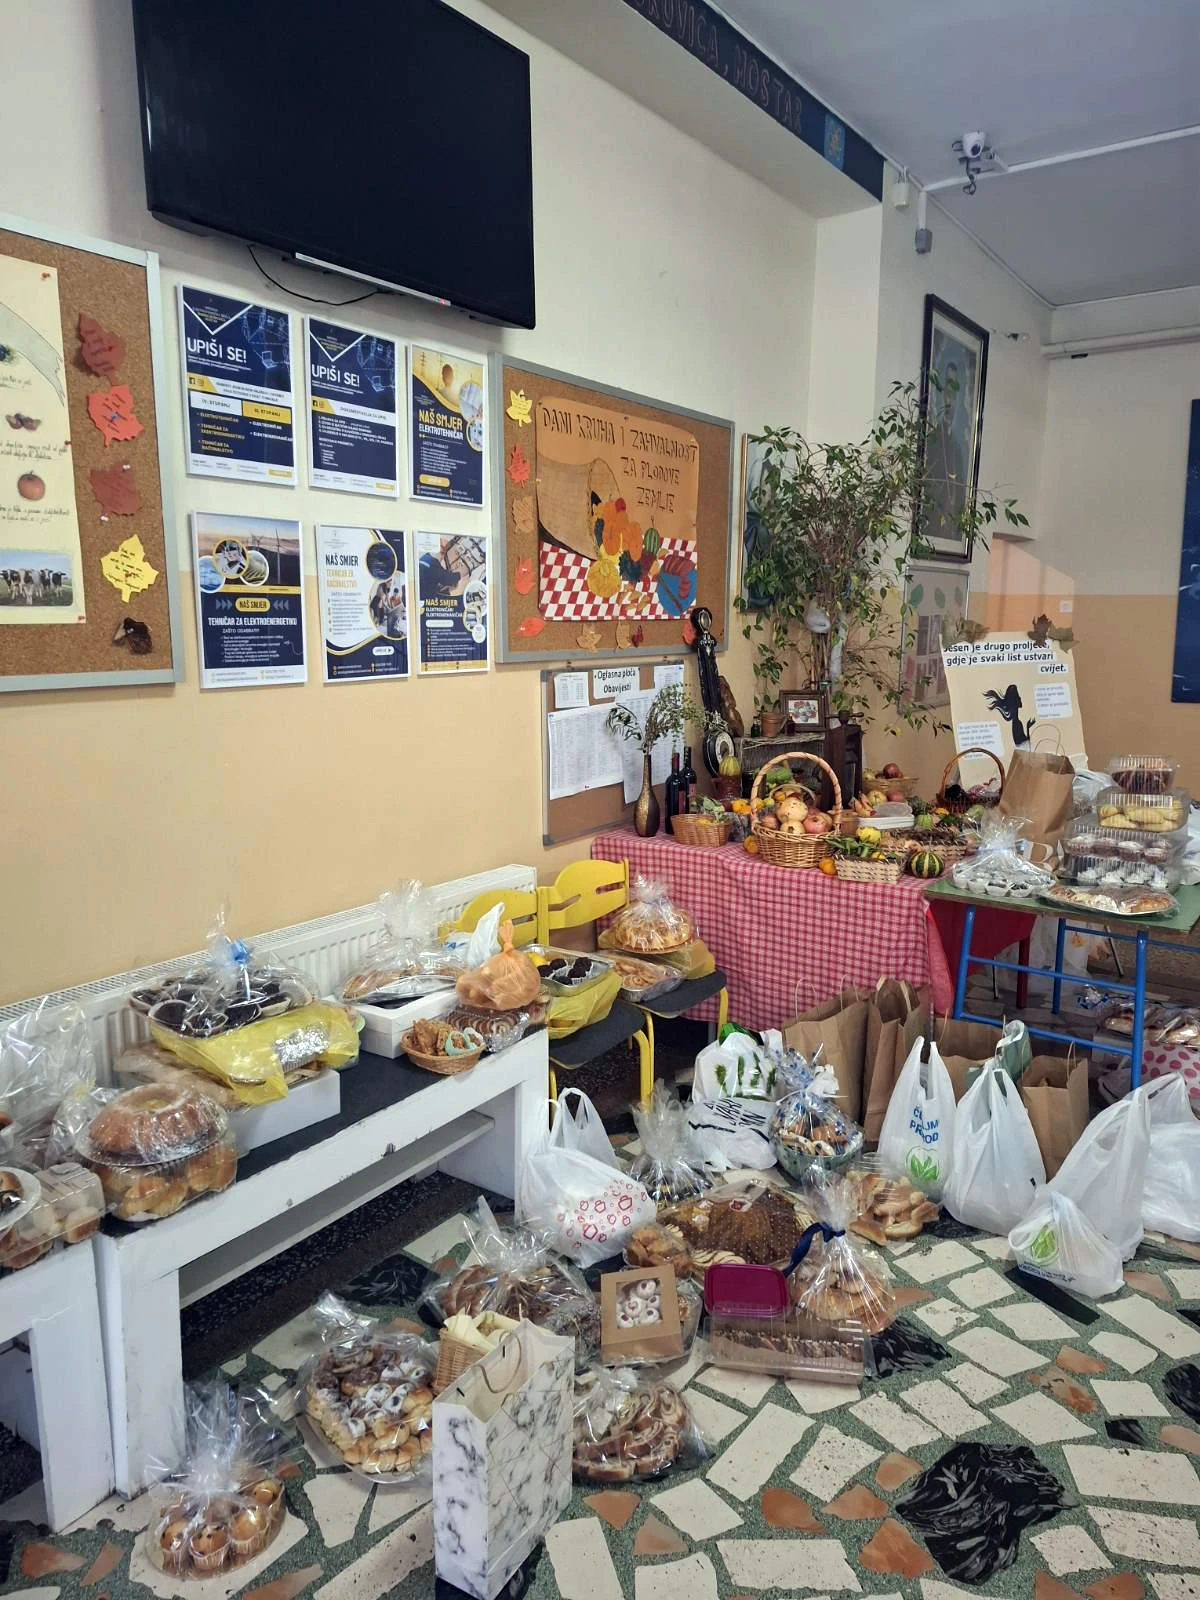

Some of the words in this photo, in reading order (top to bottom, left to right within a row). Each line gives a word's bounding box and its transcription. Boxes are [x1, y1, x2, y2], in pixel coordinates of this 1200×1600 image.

[734, 45, 802, 132] MOSTAR
[187, 337, 223, 359] UPIŠI
[226, 346, 247, 364] SE!
[311, 364, 341, 383] UPIŠI
[343, 371, 360, 388] SE!
[418, 408, 435, 424] NAŠ
[436, 413, 463, 431] SMJER
[418, 423, 464, 440] ELEKTROTEHNIČAR
[542, 407, 572, 437] DANI
[577, 414, 615, 445] KRUHA
[620, 426, 625, 447] I
[630, 429, 697, 465] ZAHVALNOST
[620, 456, 637, 478] ZA
[640, 460, 680, 485] PLODOVE
[636, 486, 675, 513] ZEMLJE
[325, 553, 339, 566] NAŠ
[340, 554, 359, 567] SMJER
[239, 598, 250, 609] NAŠ
[250, 600, 267, 609] SMJER
[425, 597, 439, 607] NAŠ
[439, 598, 458, 608] SMJER
[208, 616, 235, 626] TEHNIČAR
[235, 617, 243, 626] ZA
[243, 617, 298, 626] ELEKTROENERGETIKU
[972, 642, 981, 653] je
[983, 641, 1011, 653] drugo
[946, 656, 966, 667] gdje
[968, 656, 978, 666] je
[980, 653, 1005, 663] svaki
[1007, 652, 1021, 662] list
[1023, 651, 1054, 661] ustvari
[597, 669, 622, 681] Oglasna
[622, 668, 636, 679] ploča
[1040, 663, 1067, 674] cvijet.
[603, 684, 632, 694] Obavijesti
